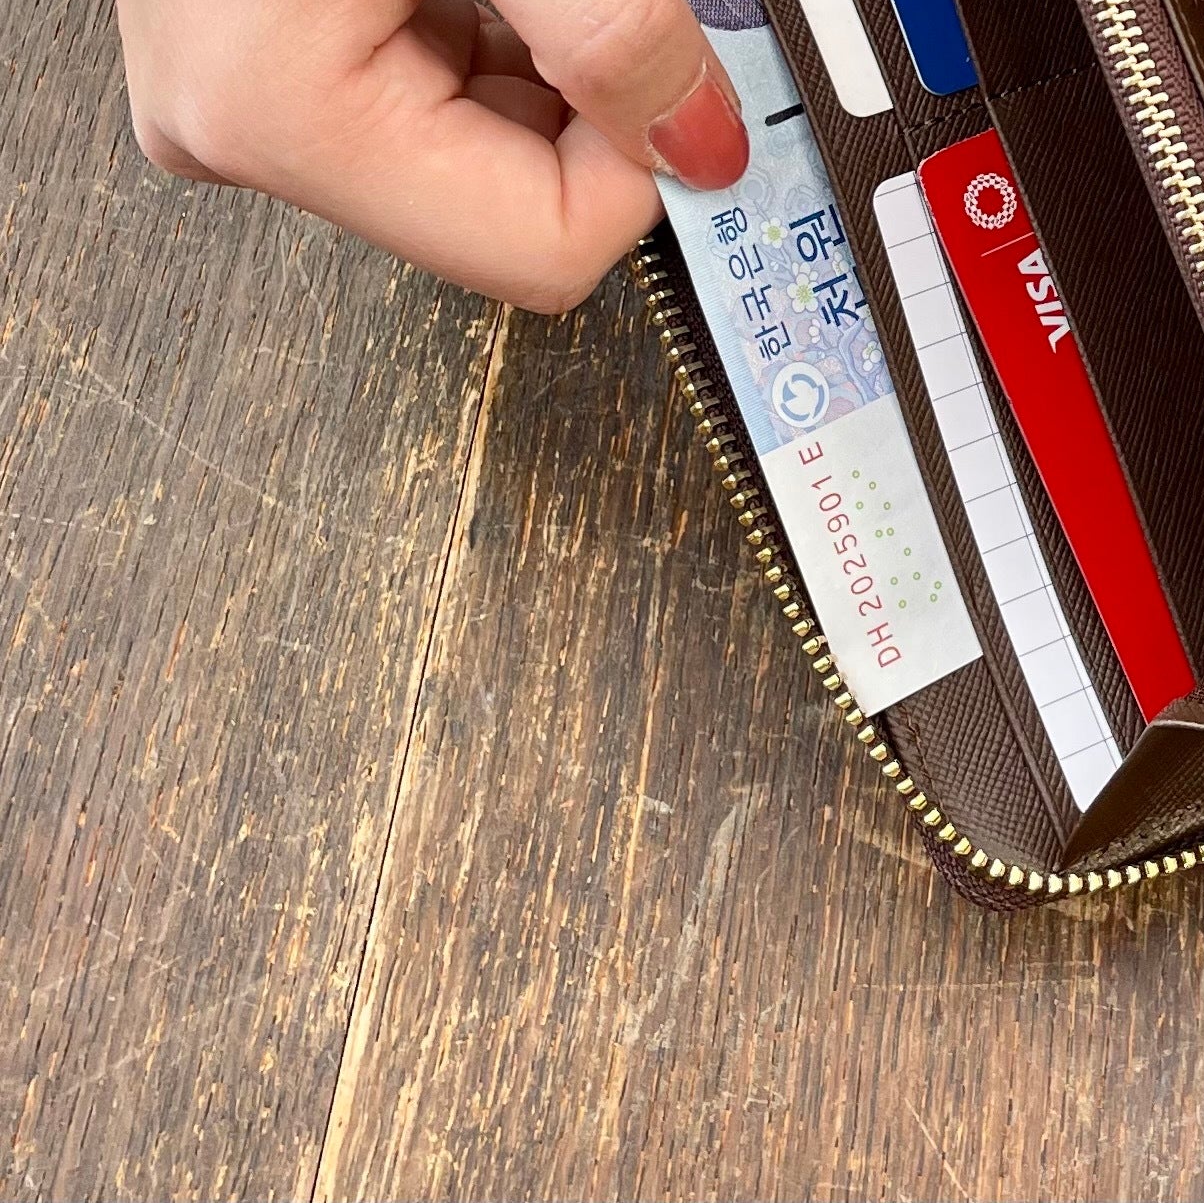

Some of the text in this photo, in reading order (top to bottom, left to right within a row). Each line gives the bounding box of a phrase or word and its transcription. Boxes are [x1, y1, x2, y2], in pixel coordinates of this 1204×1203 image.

[711, 206, 792, 361] 한국은행
[1017, 247, 1071, 354] VISA
[798, 441, 902, 668] DH 2025901 E
